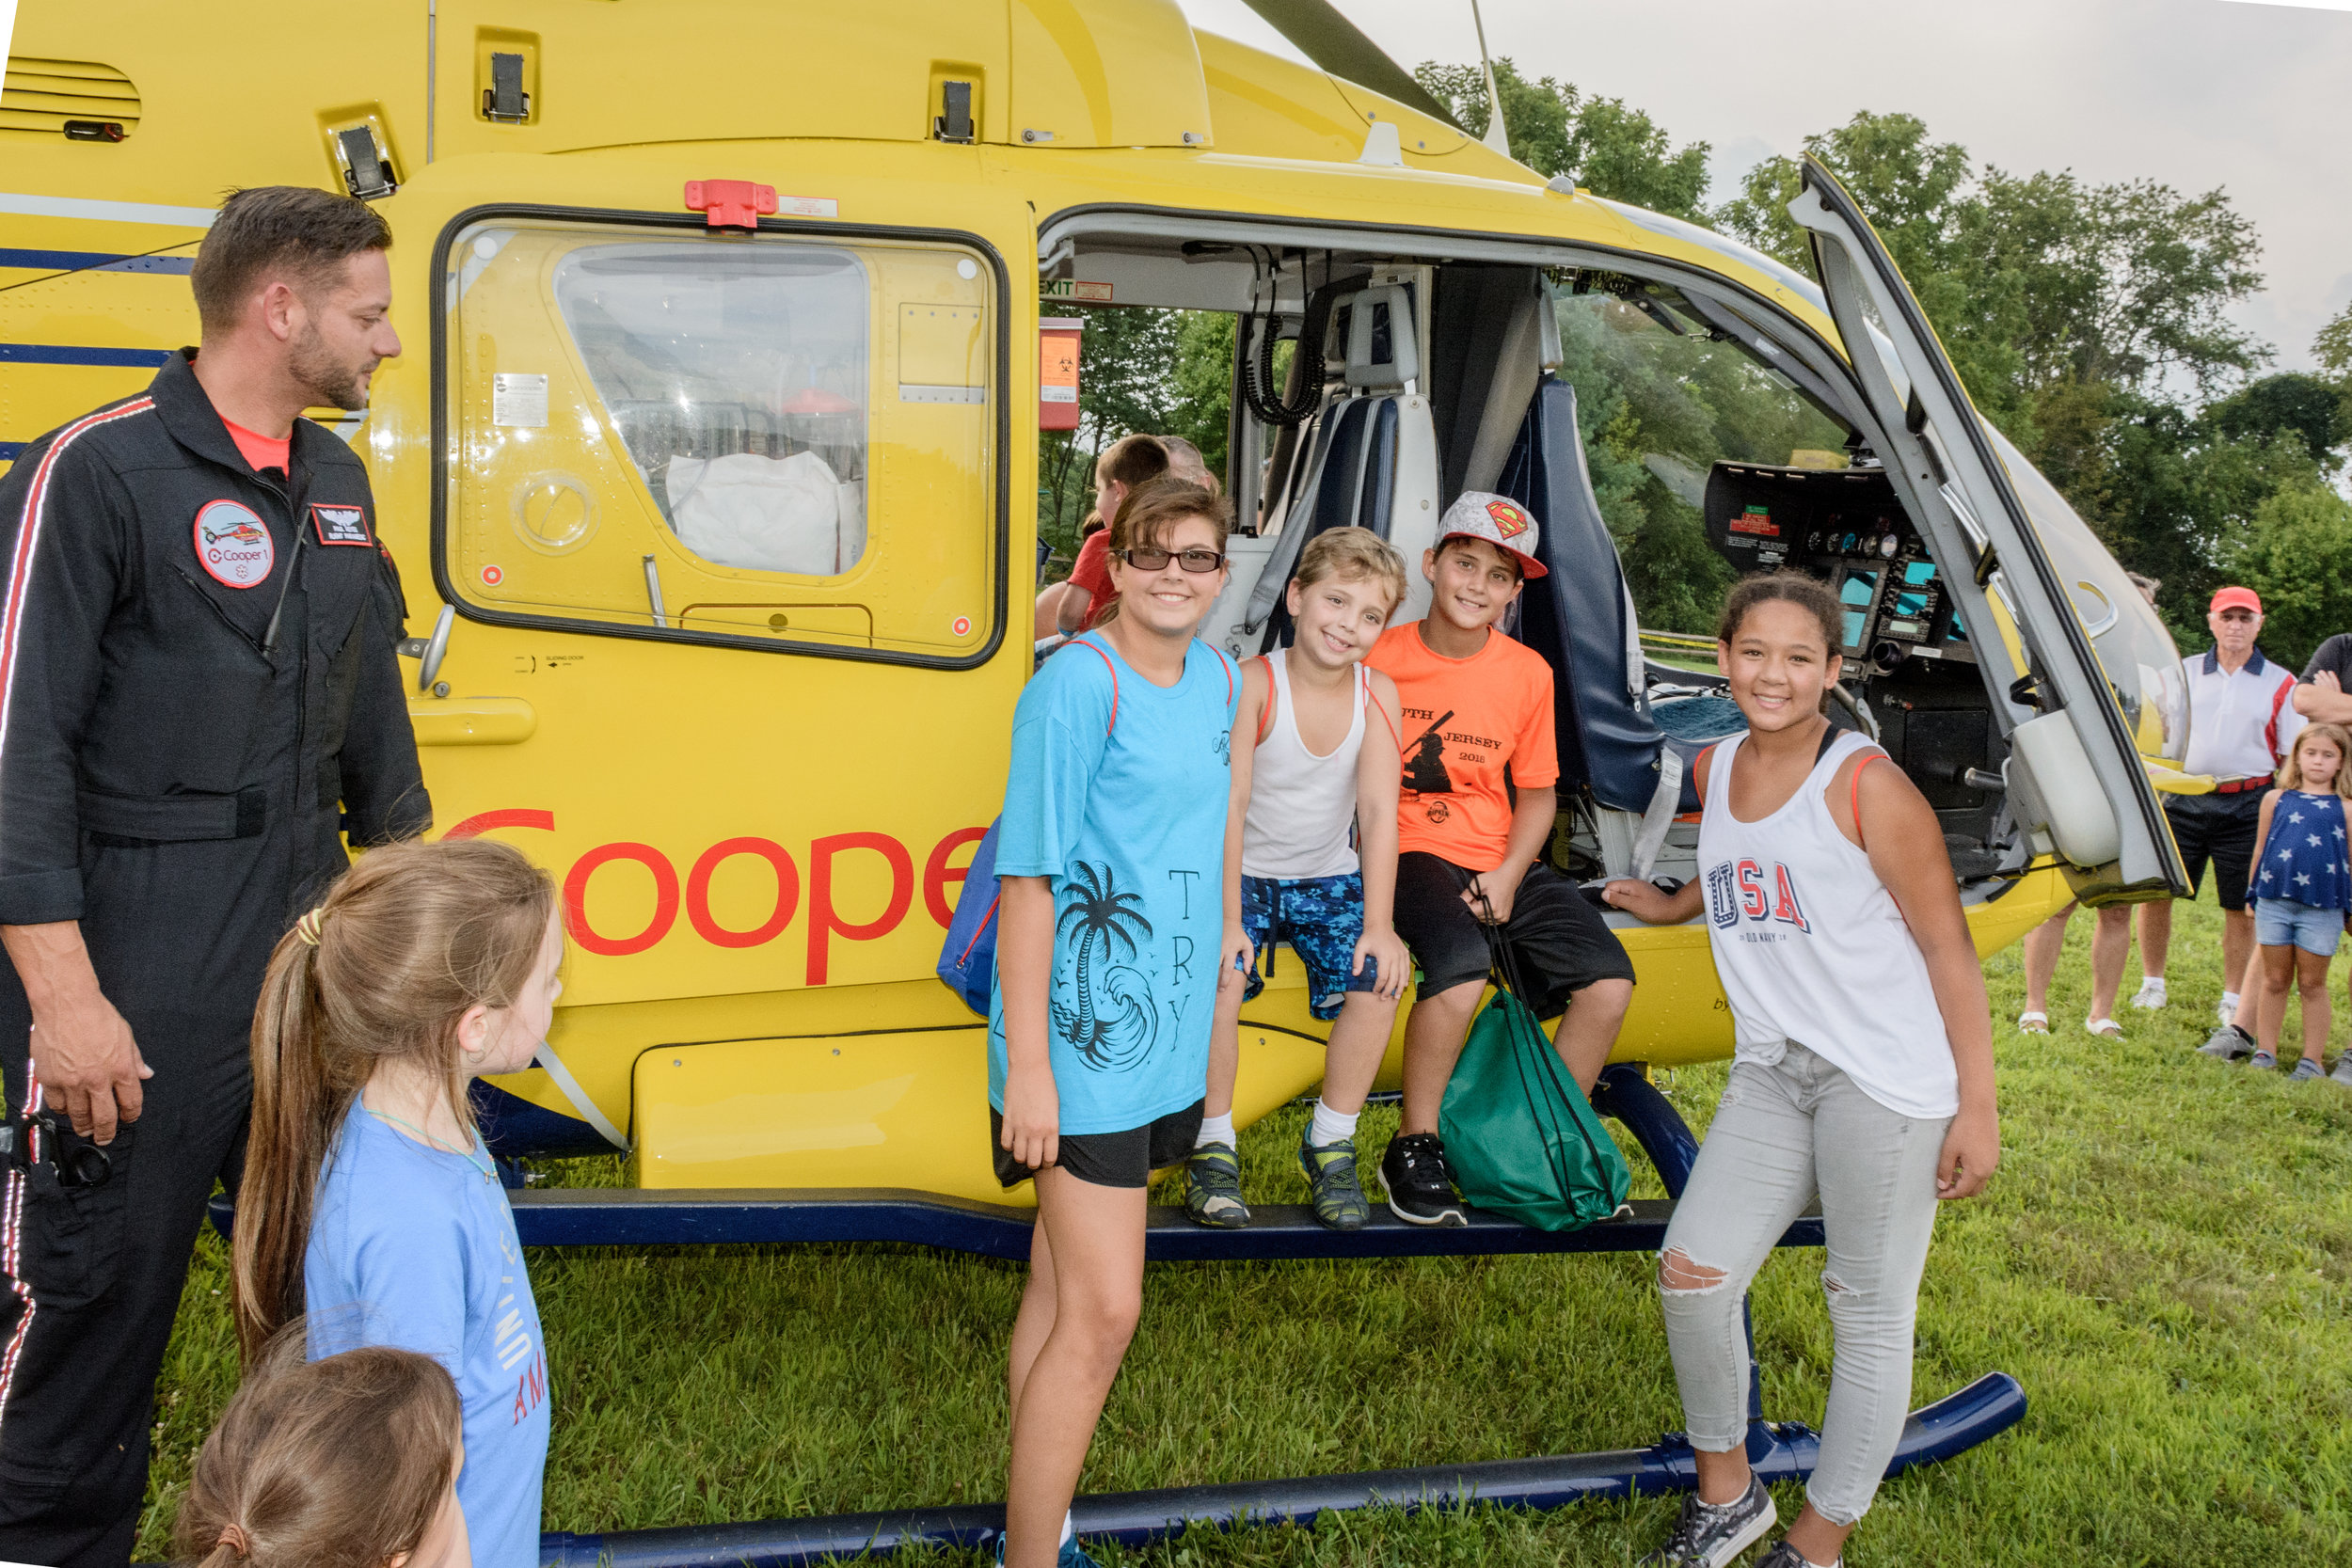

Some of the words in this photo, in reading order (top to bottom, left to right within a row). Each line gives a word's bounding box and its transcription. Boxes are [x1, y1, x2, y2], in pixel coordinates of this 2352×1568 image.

[1040, 280, 1073, 295] EXIT
[224, 549, 262, 562] Cooper
[263, 549, 268, 560] 1
[1443, 733, 1502, 750] JERSEY
[1458, 752, 1486, 763] 2018
[439, 808, 991, 986] oope
[1707, 857, 1812, 935] USA
[1746, 932, 1757, 942] OLD
[1758, 932, 1776, 942] NAVY
[1713, 998, 1729, 1012] by
